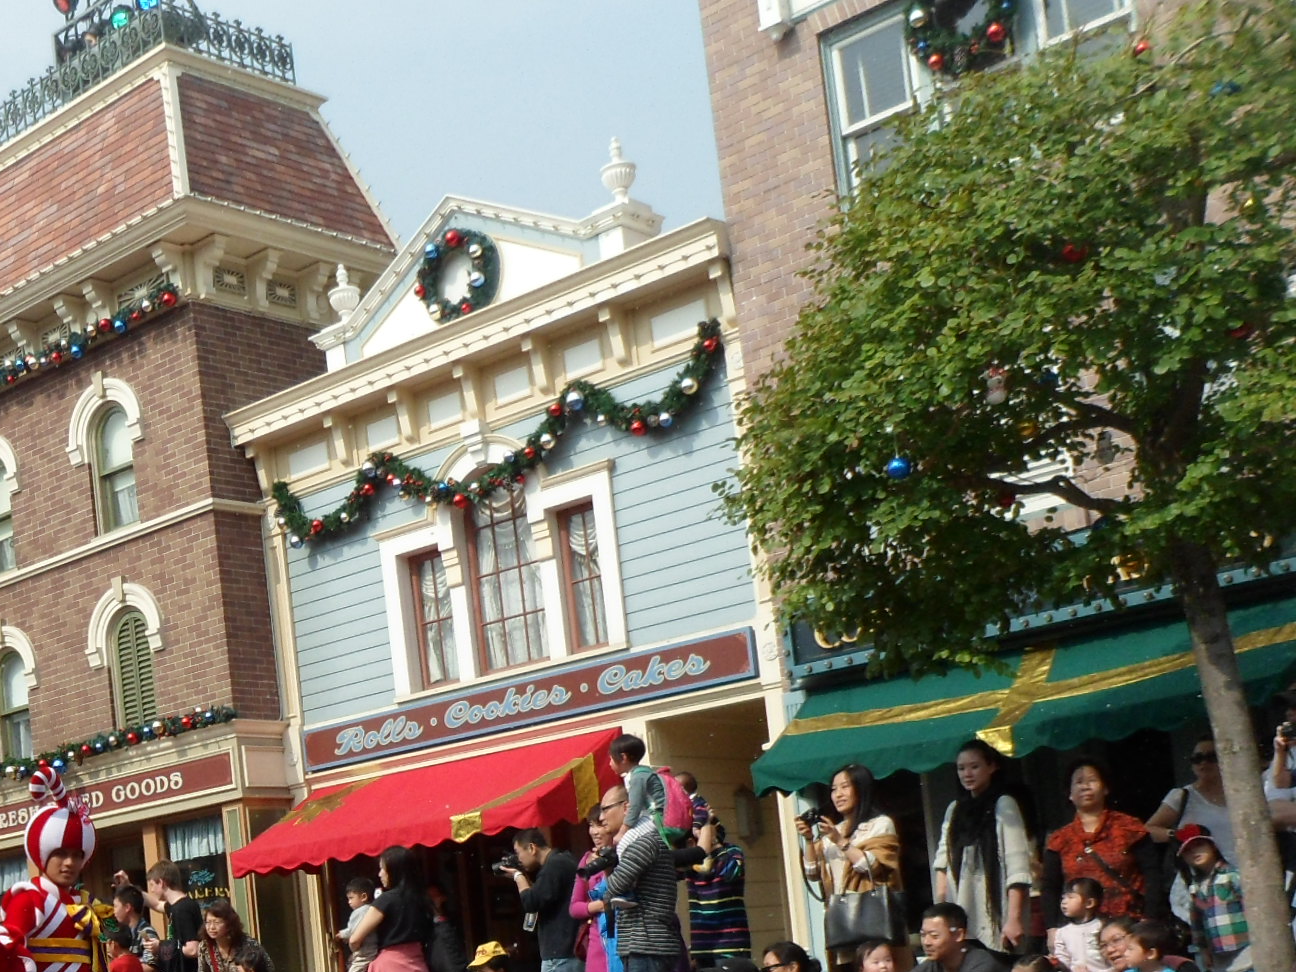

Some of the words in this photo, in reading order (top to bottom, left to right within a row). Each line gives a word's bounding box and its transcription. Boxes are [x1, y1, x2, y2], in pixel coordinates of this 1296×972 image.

[334, 715, 424, 756] Rolls
[444, 684, 572, 729] Cookies
[597, 652, 710, 694] Cakes
[111, 771, 183, 803] GOODS
